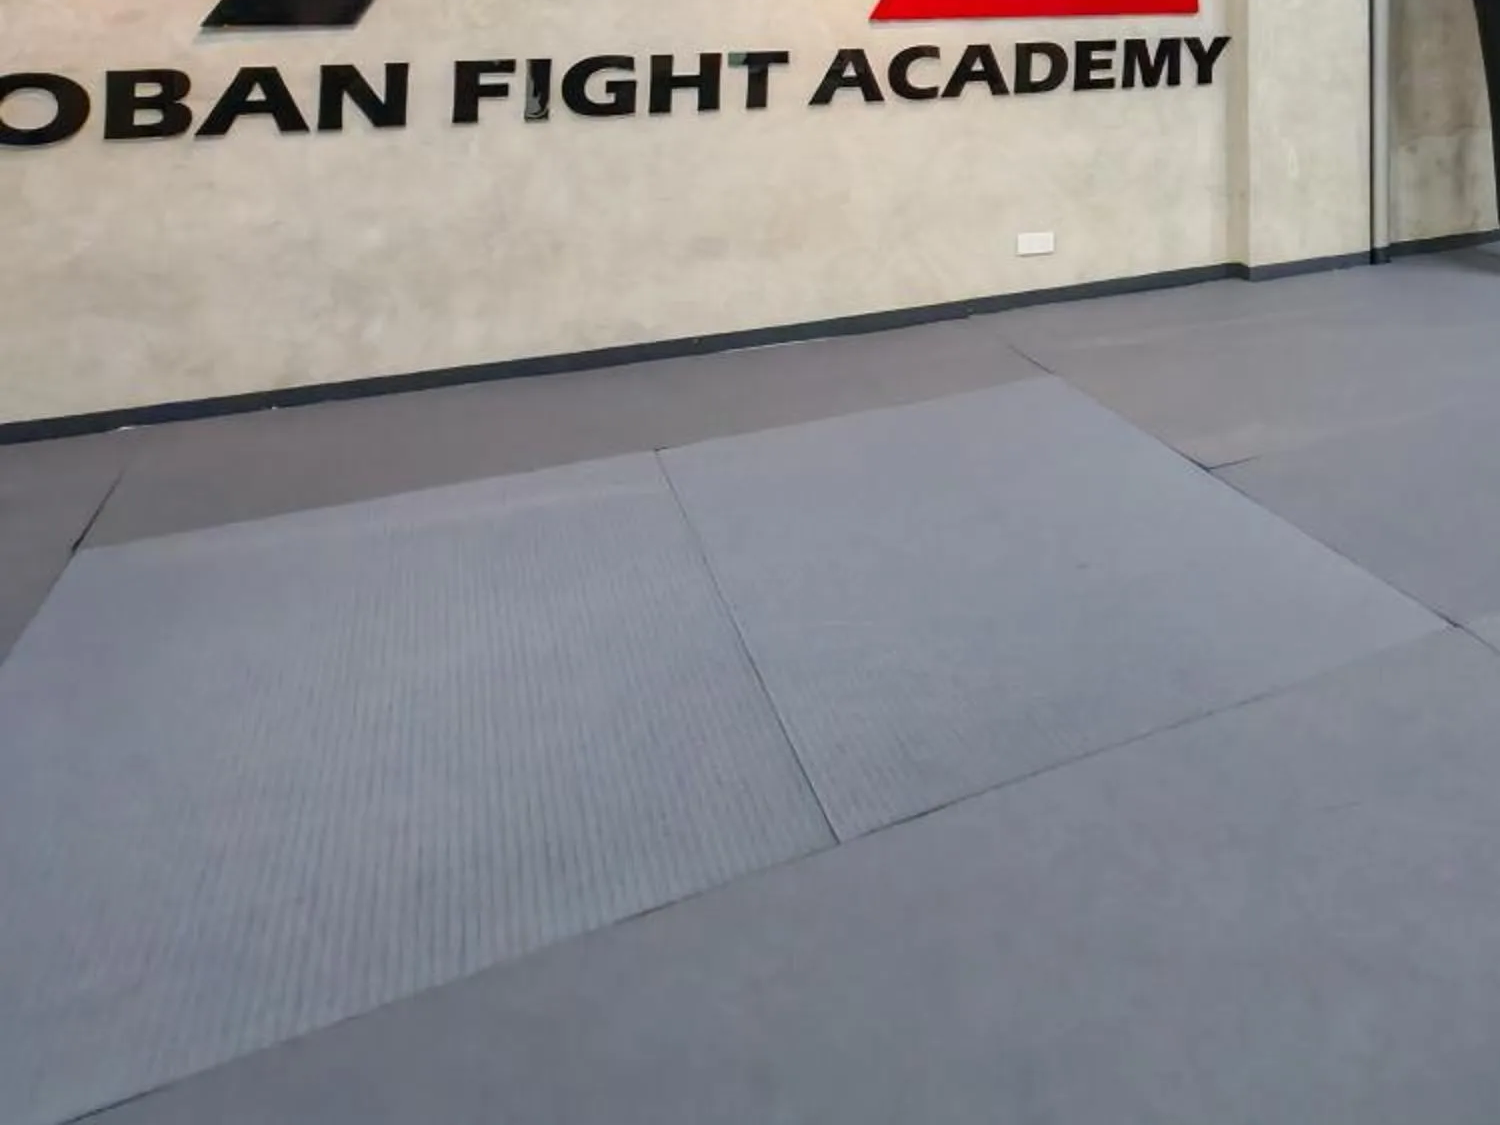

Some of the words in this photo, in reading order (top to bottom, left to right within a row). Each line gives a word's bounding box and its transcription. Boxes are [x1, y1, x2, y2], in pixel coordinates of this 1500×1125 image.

[0, 62, 410, 147] OBAN
[451, 50, 790, 124] FIGHT
[808, 36, 1232, 106] ACADEMY
